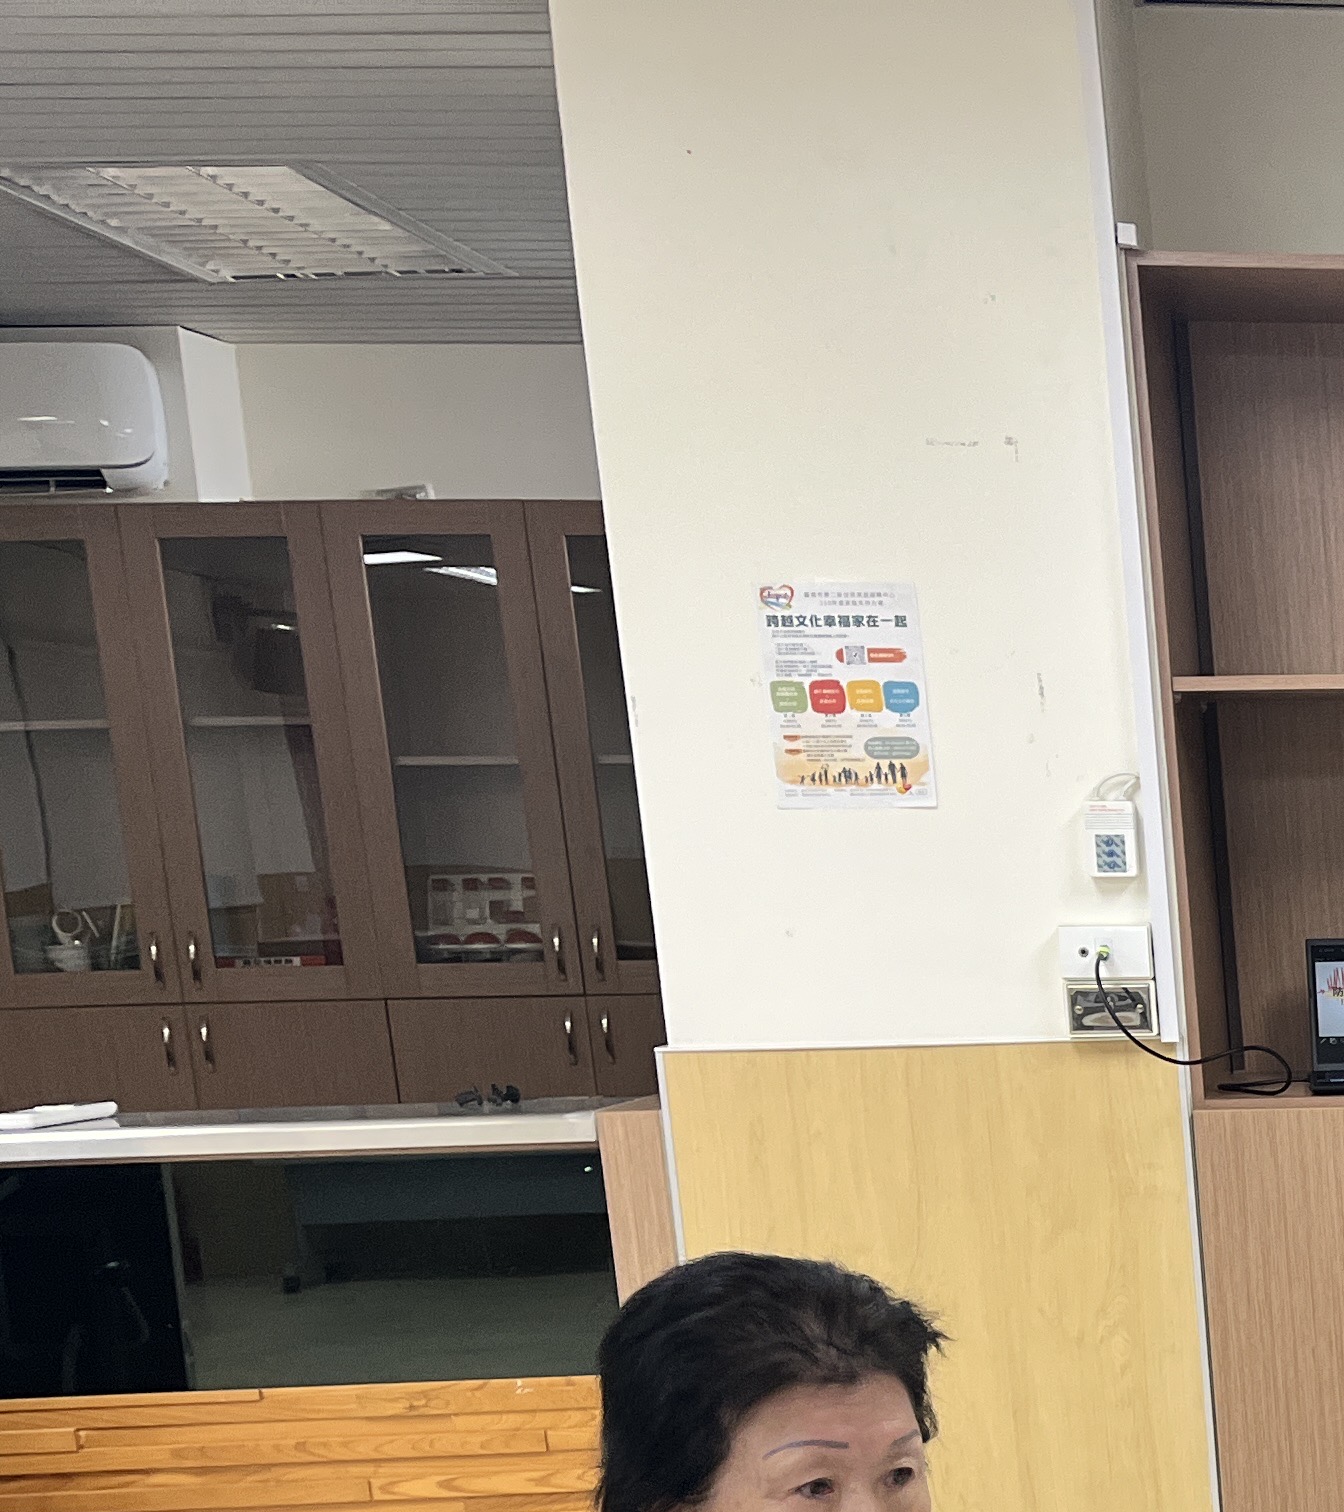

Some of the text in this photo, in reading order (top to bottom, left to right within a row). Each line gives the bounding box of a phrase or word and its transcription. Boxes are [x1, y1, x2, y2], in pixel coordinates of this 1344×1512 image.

[765, 614, 908, 628] 跨越文化幸福家在一起
